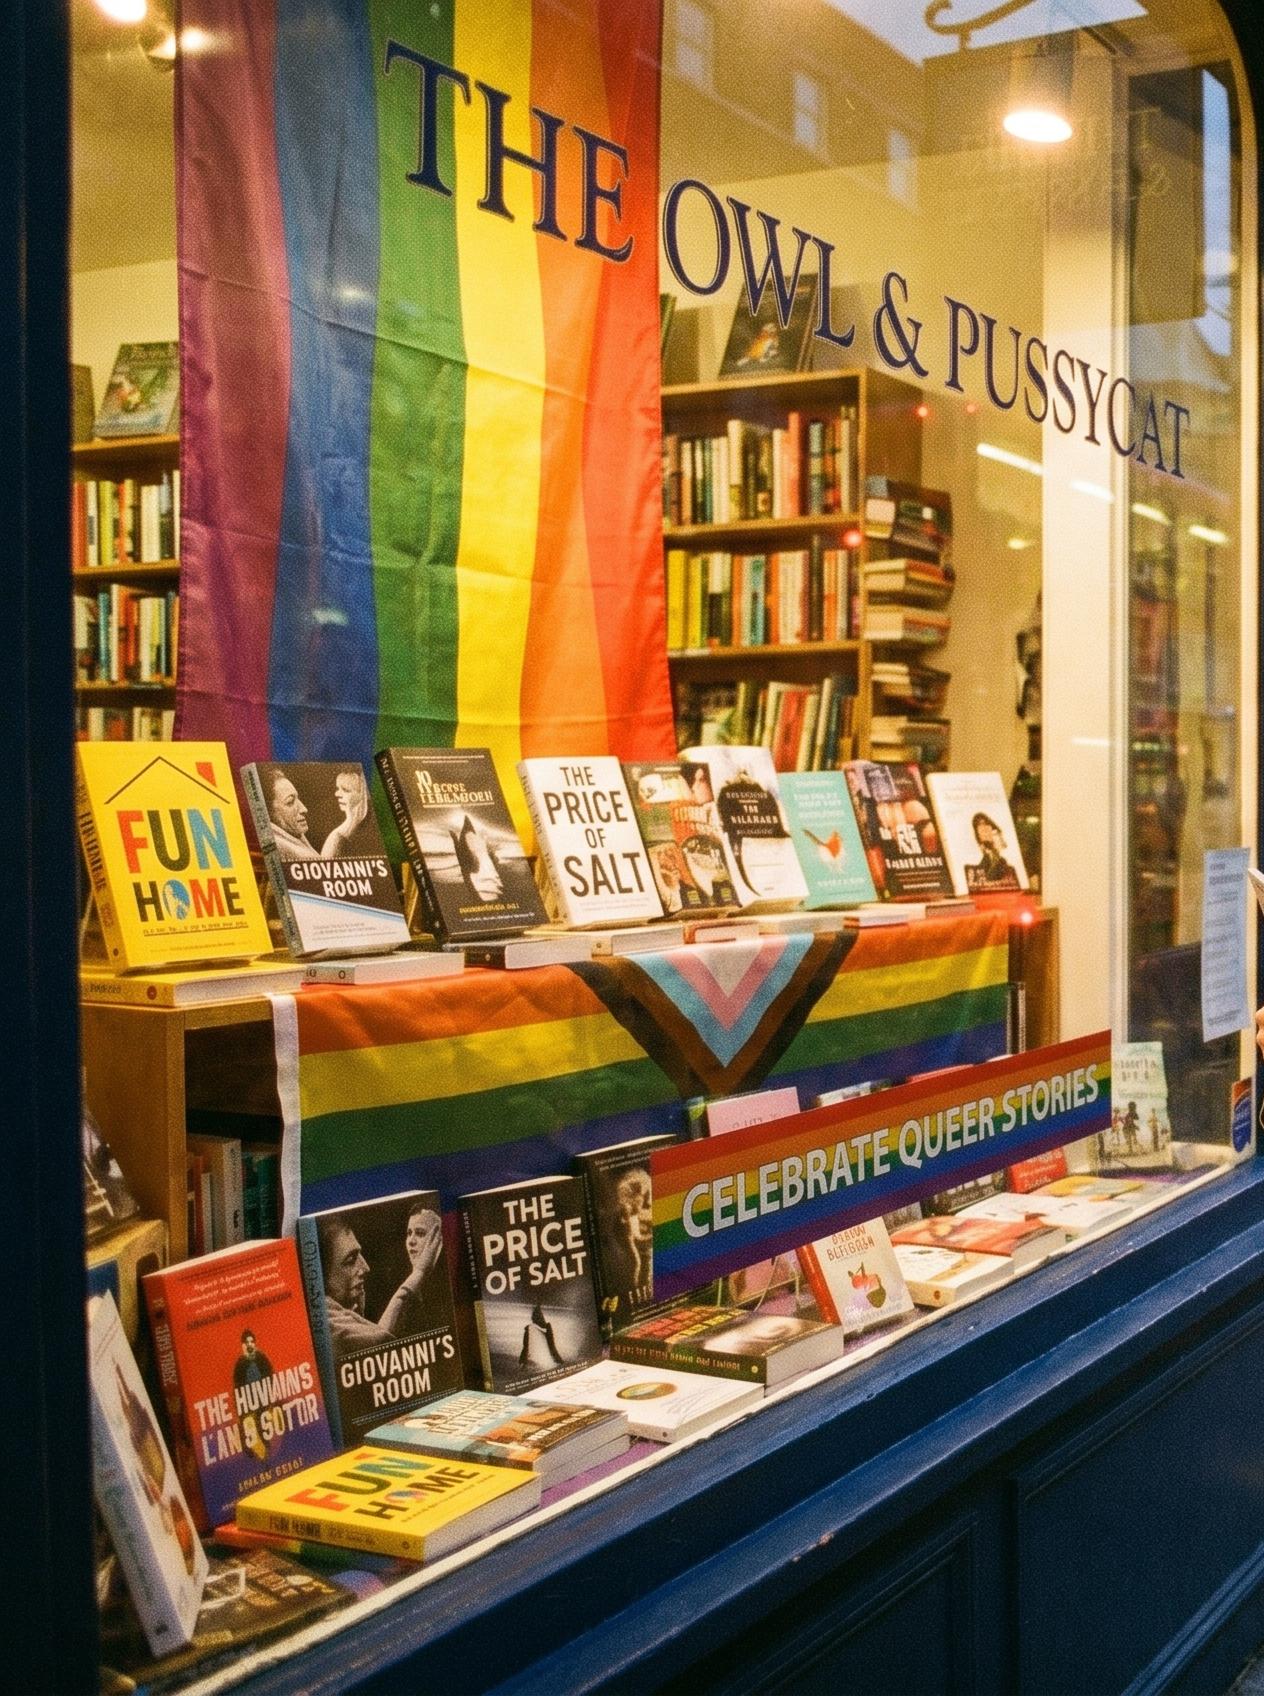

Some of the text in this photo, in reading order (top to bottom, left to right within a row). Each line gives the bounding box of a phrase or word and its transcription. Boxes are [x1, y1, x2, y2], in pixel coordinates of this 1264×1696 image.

[383, 38, 1190, 479] THE OWL & PUSSYCAT
[559, 766, 596, 787] THE
[543, 790, 629, 826] PRICE
[116, 808, 234, 874] FUN
[584, 828, 607, 849] OF
[291, 859, 389, 881] GIOVANNI'S
[323, 879, 373, 898] ROOM
[563, 852, 645, 898] SALT
[132, 877, 245, 922] HOME
[681, 1063, 1099, 1238] CELEBRATE QUEER STORIES
[503, 1193, 556, 1225] THE
[483, 1217, 585, 1268] PRICE
[485, 1252, 587, 1296] OF SALT
[340, 1334, 455, 1389] GIOVANNI'S
[372, 1367, 432, 1409] ROOM
[193, 1391, 234, 1432] THE
[286, 1456, 436, 1513] FUN
[354, 1466, 480, 1520] HOME
